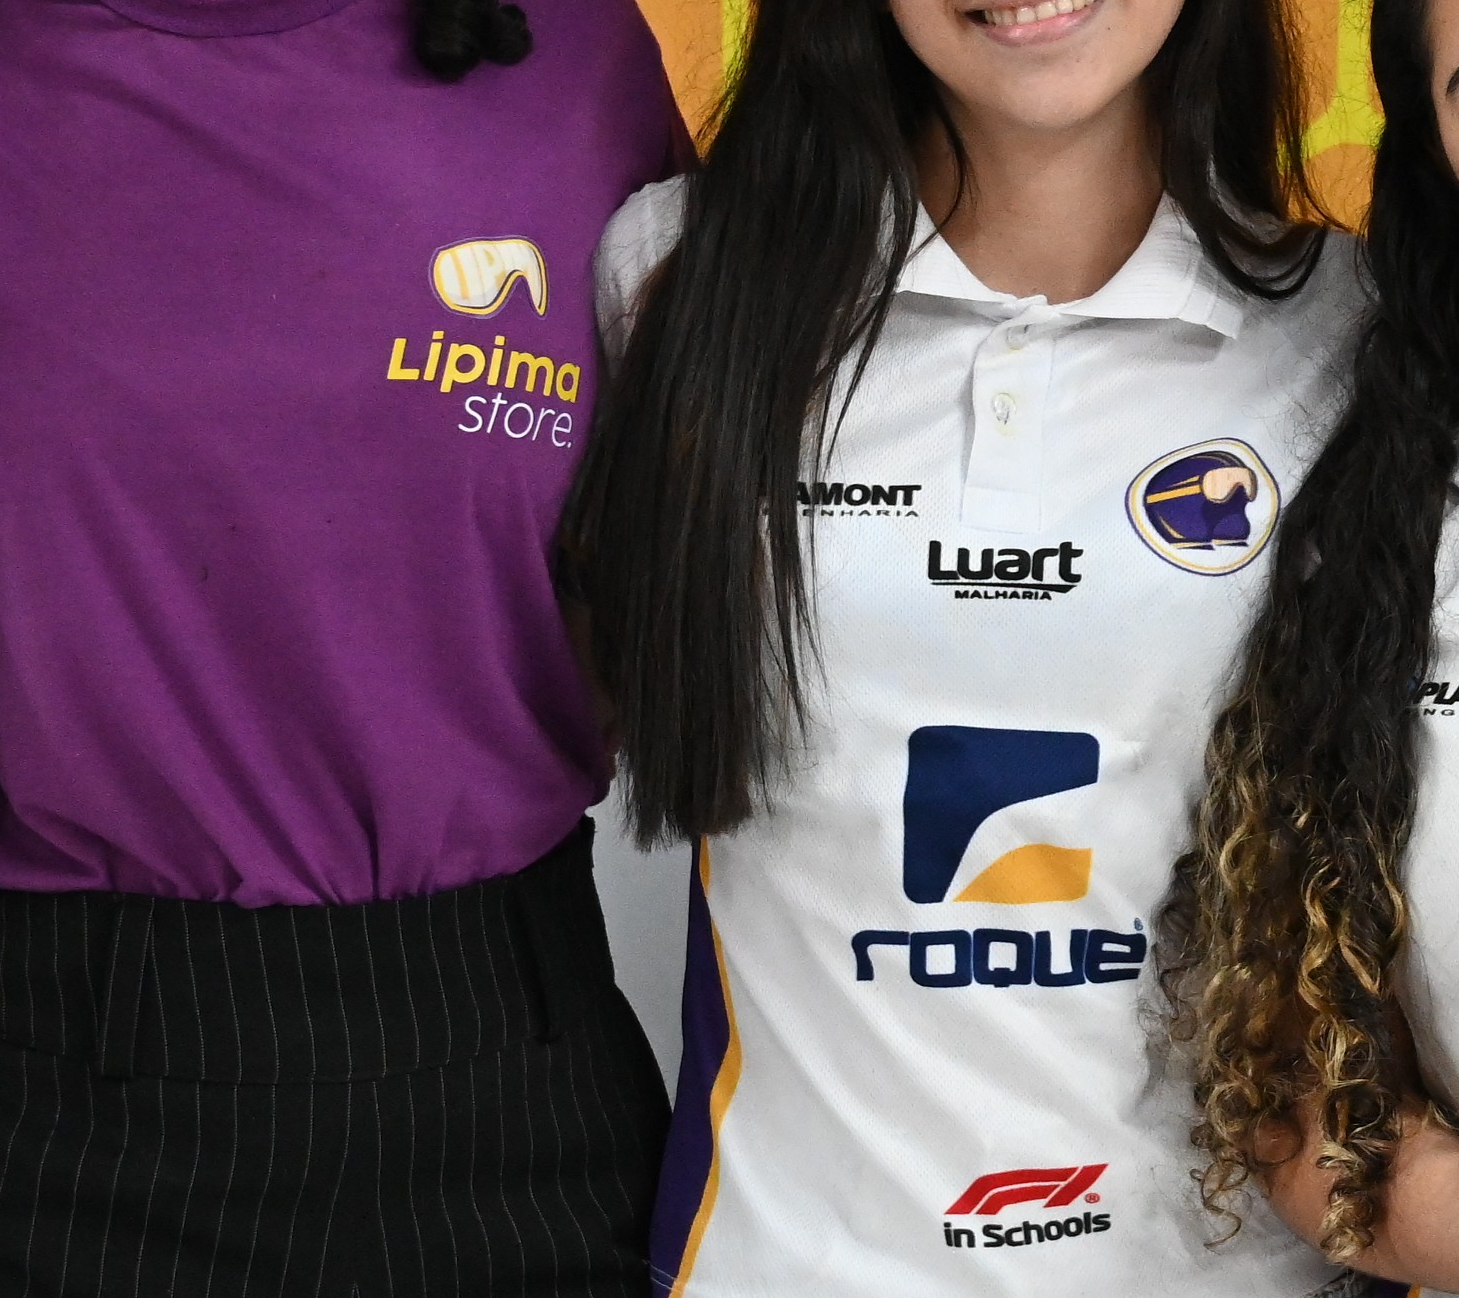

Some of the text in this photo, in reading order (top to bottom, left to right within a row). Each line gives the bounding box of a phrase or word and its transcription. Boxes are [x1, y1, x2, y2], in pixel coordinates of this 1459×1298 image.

[387, 331, 581, 403] Lipima
[928, 540, 1084, 583] Luart
[954, 589, 1052, 601] MALHARIA
[943, 1211, 1112, 1248] in Schools
